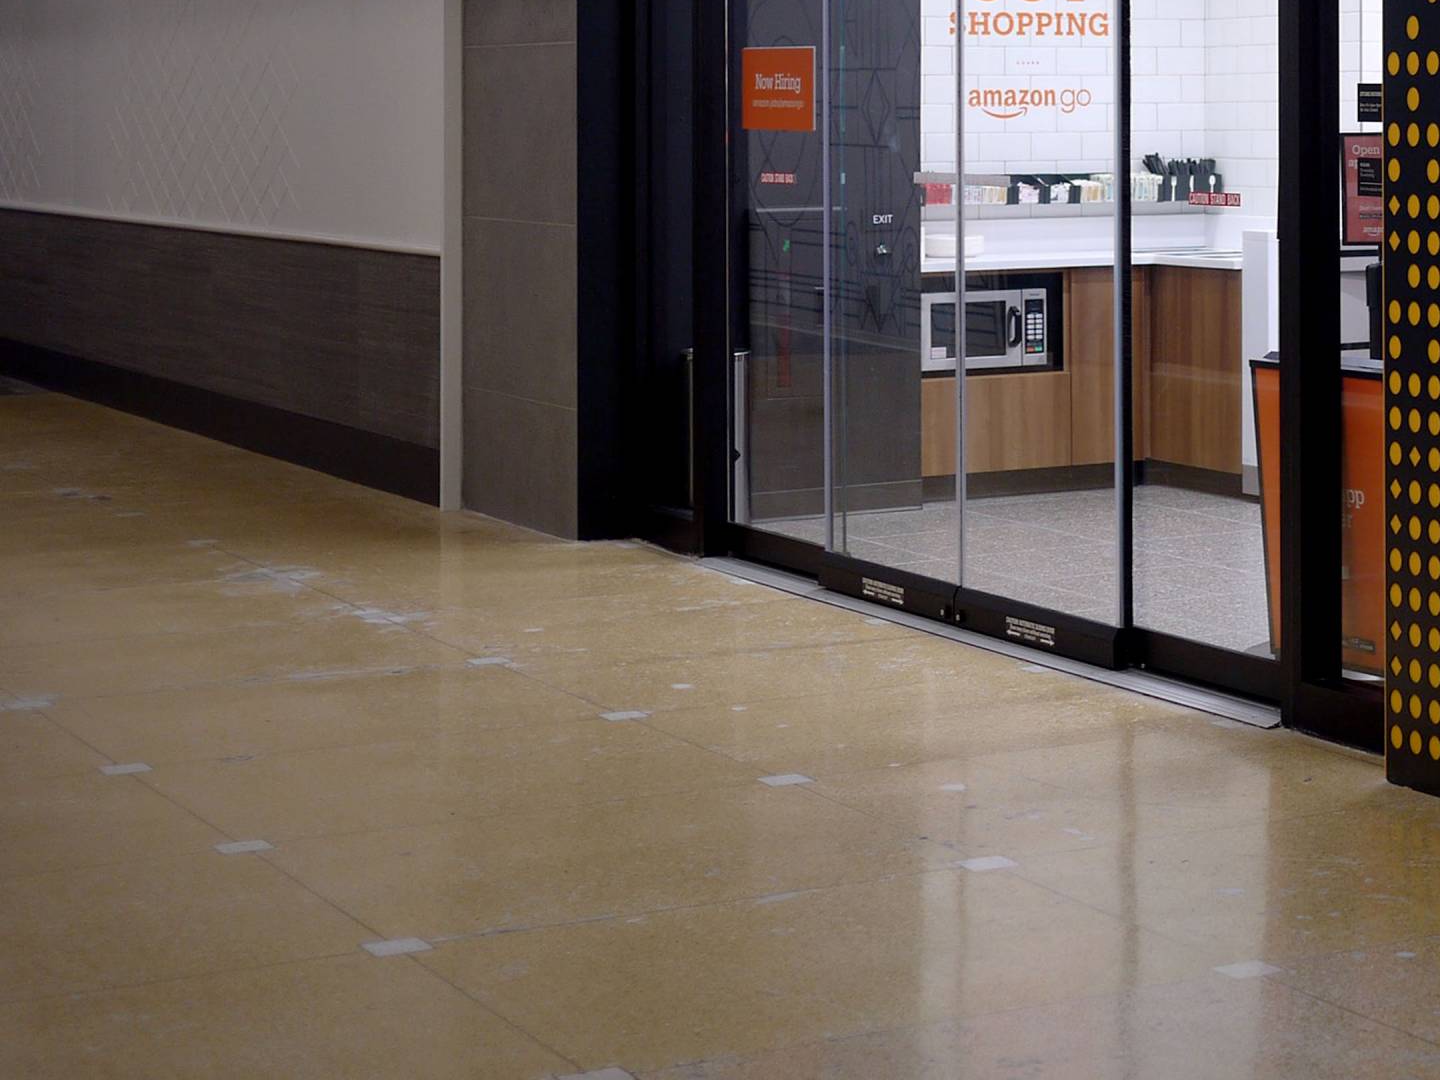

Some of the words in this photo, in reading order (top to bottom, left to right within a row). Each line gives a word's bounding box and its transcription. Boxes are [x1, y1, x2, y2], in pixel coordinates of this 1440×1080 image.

[755, 73, 773, 90] Now
[774, 73, 801, 94] Hiring
[968, 88, 1056, 108] amazon
[1060, 89, 1092, 114] go
[1352, 144, 1380, 158] Open
[1210, 193, 1226, 205] STAND
[1227, 194, 1240, 206] BACK
[872, 214, 893, 224] EXIT
